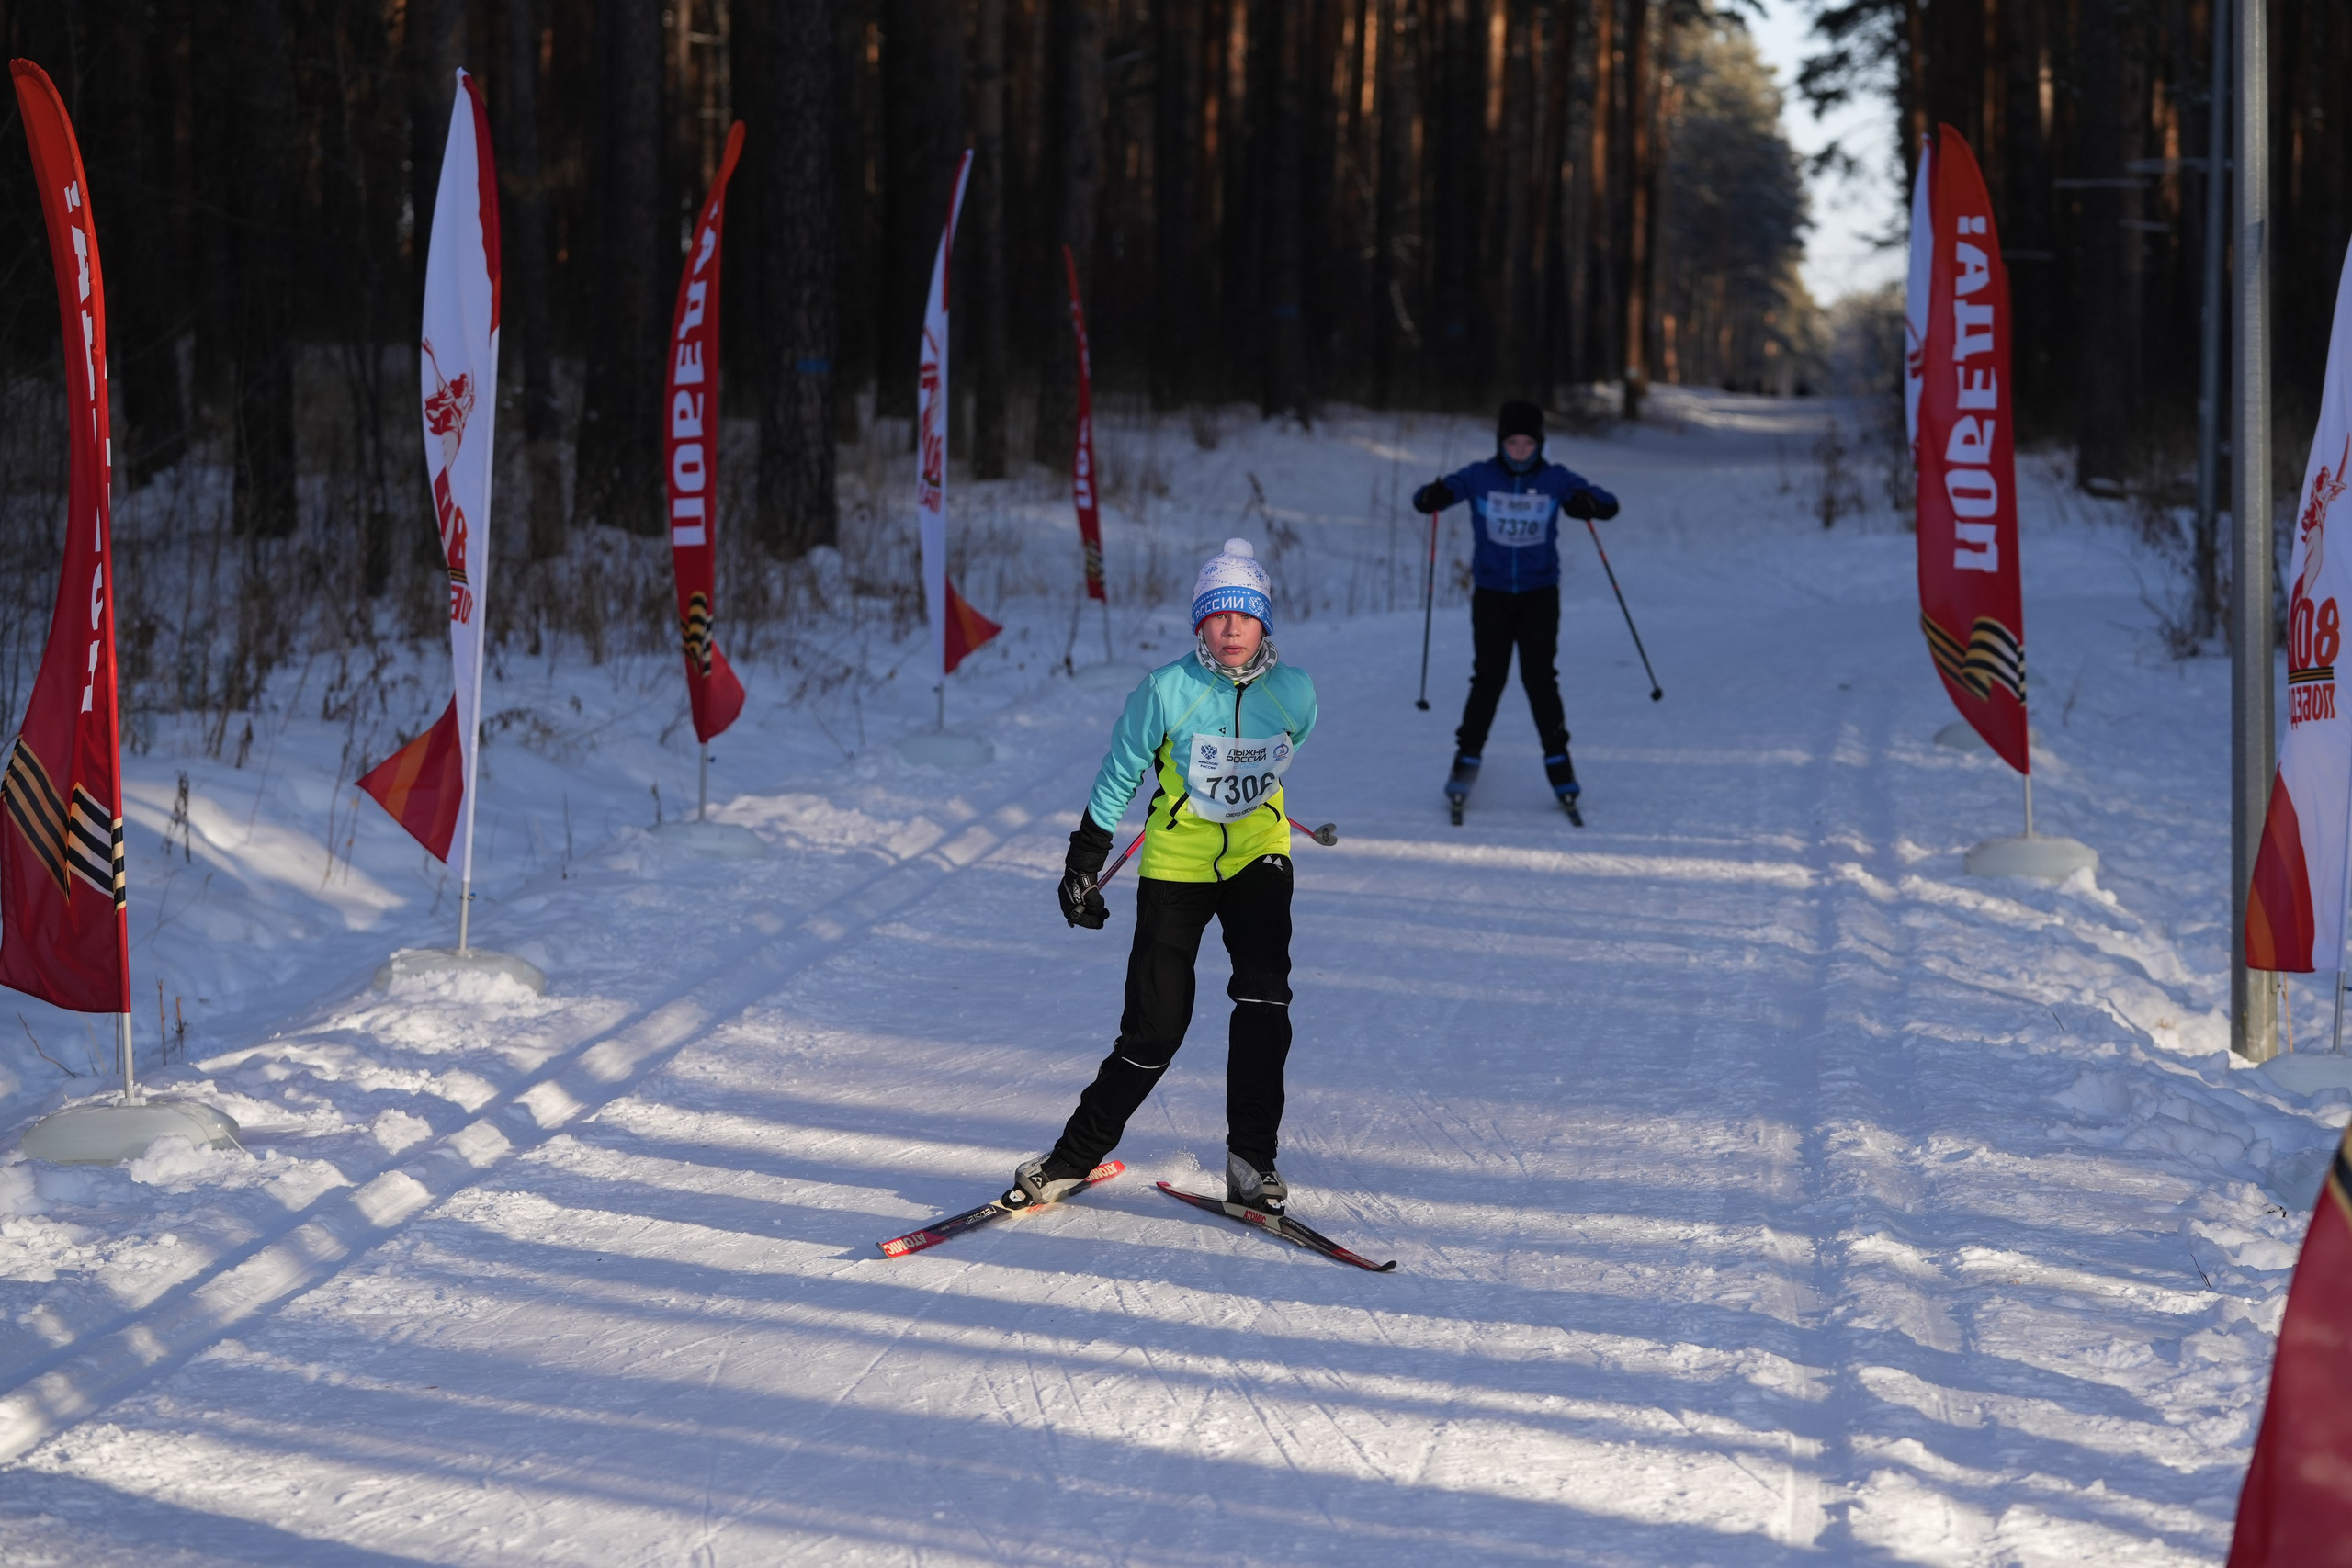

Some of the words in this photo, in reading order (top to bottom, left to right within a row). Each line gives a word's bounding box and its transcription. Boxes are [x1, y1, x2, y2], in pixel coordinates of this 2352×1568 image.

[1195, 596, 1244, 620] РОССИИ
[1226, 754, 1267, 763] РОССИИ
[1228, 747, 1267, 757] ЛЫЖНЯ
[1233, 761, 1260, 770] 2025
[1206, 772, 1275, 805] 7306
[1243, 1210, 1267, 1225] ATOMIC
[884, 1232, 927, 1255] ATOMIC
